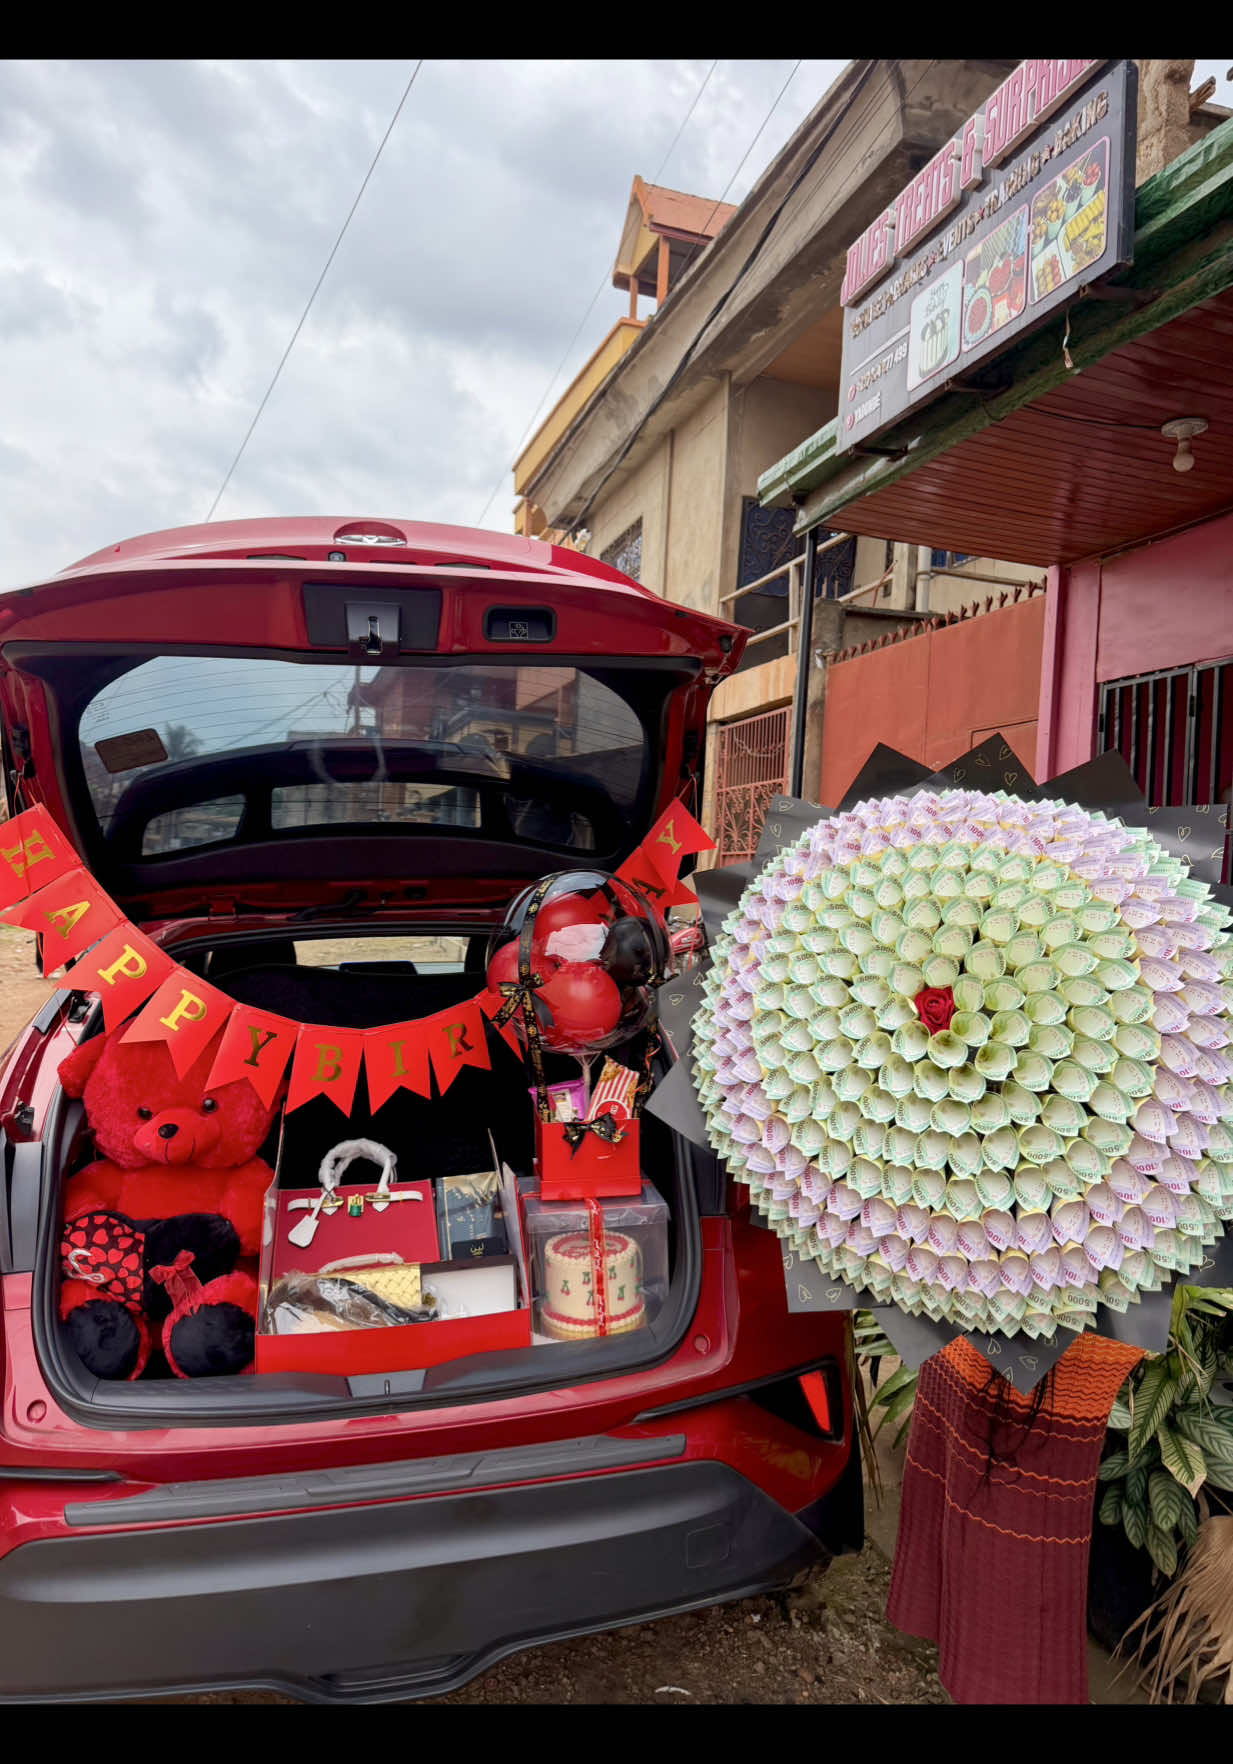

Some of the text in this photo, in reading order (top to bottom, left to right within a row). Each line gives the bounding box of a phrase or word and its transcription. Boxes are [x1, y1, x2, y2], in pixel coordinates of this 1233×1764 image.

[893, 138, 955, 258] TREATS
[4, 829, 278, 1067] HAPPY
[1067, 1295, 1090, 1306] 5000
